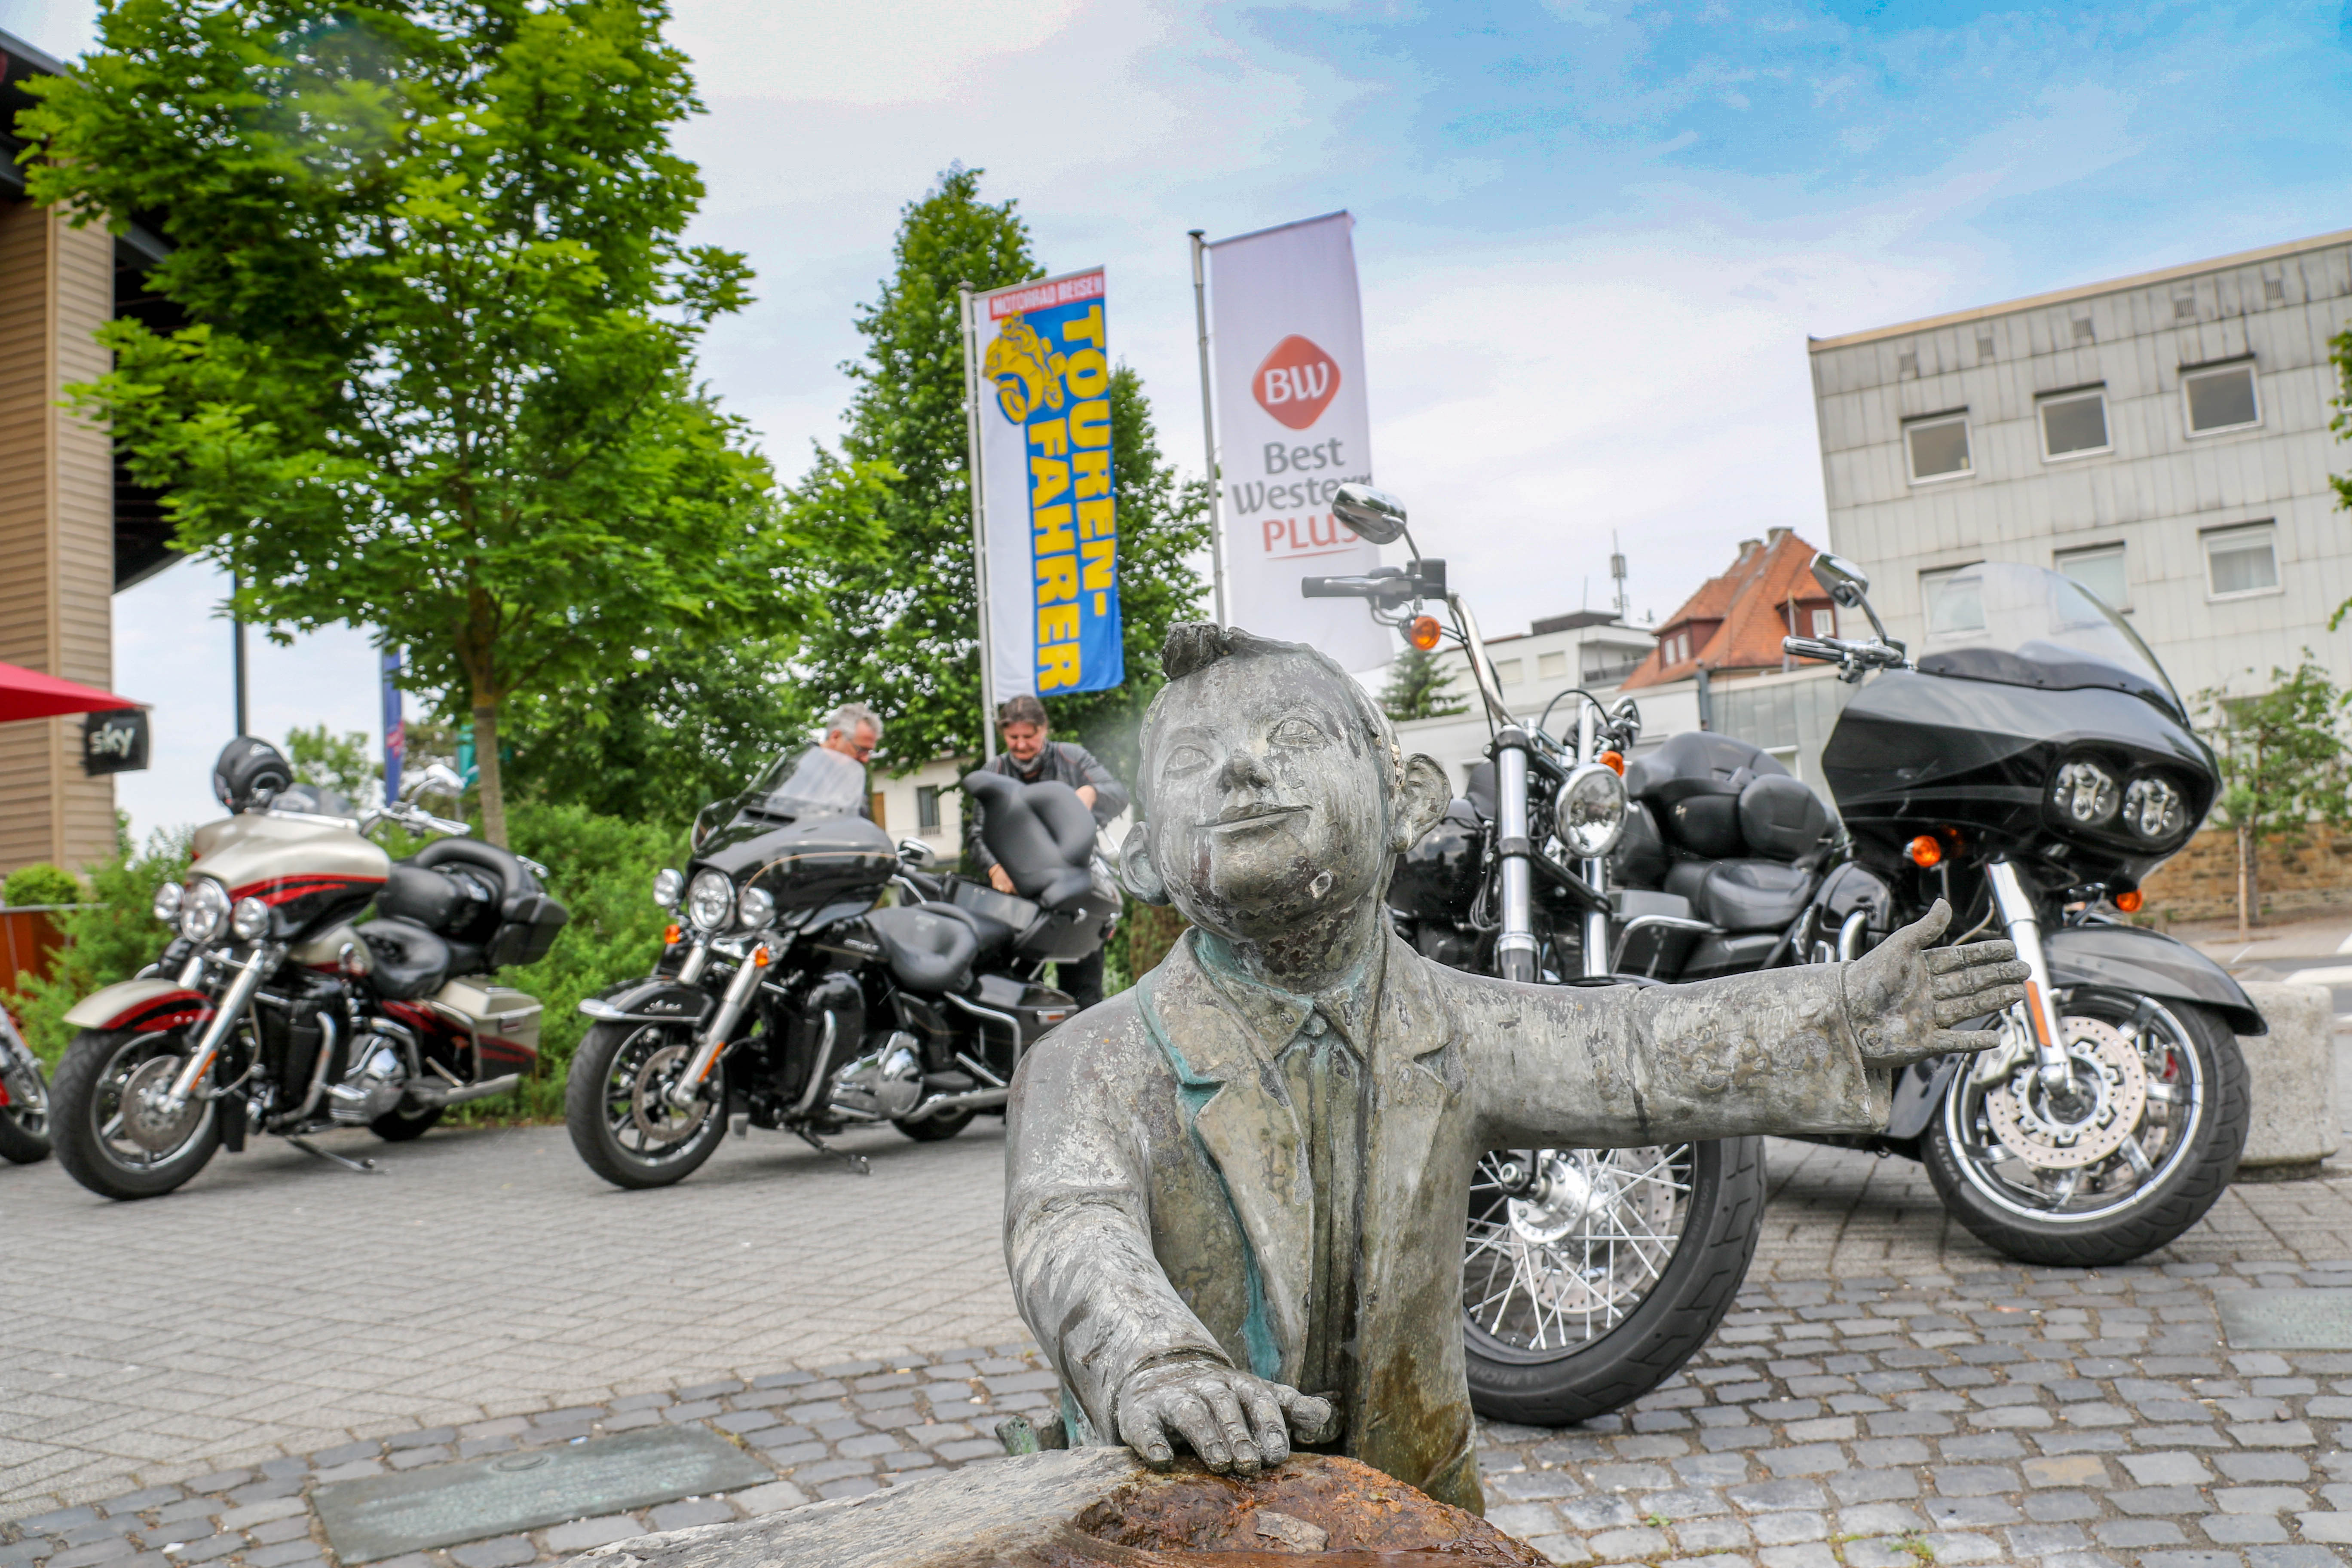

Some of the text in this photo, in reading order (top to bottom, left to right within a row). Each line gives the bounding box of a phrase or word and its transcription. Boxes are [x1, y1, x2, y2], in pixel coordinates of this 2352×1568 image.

[1057, 273, 1103, 300] REISEN
[1265, 361, 1329, 406] BW
[1063, 305, 1117, 617] TOUREN-
[1264, 437, 1345, 475] Best
[1231, 473, 1373, 515] Weste
[1029, 417, 1081, 692] FAHRER
[89, 722, 135, 758] sky
